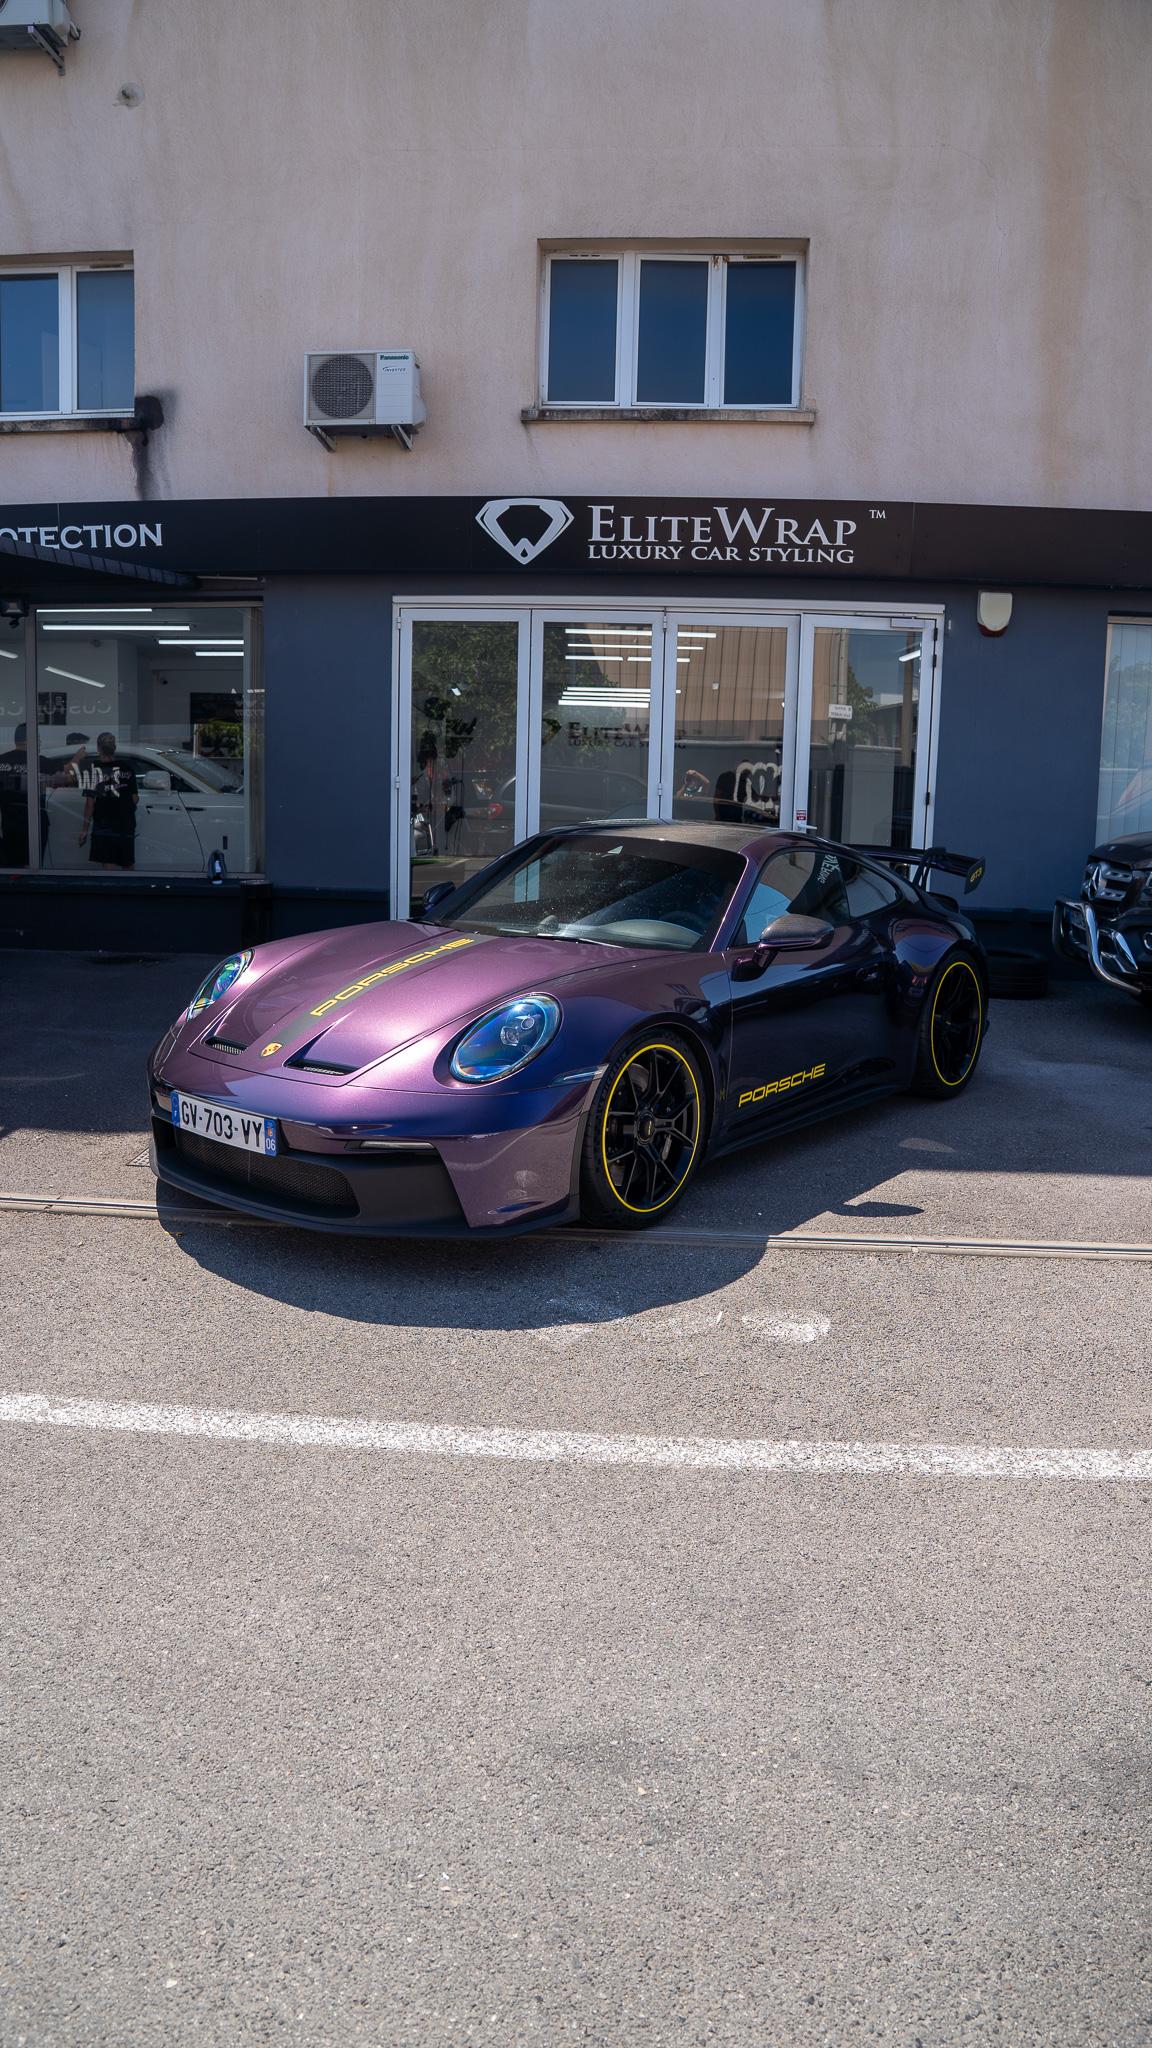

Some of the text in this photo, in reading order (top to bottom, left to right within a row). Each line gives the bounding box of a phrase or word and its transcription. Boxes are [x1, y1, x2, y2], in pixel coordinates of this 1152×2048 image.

[588, 545, 854, 564] LUXURY CAR STYLING
[310, 938, 475, 1017] PORSCHE
[738, 1063, 826, 1108] PORSCHE
[181, 1100, 262, 1148] GV-703-VY
[265, 1139, 276, 1151] 06
